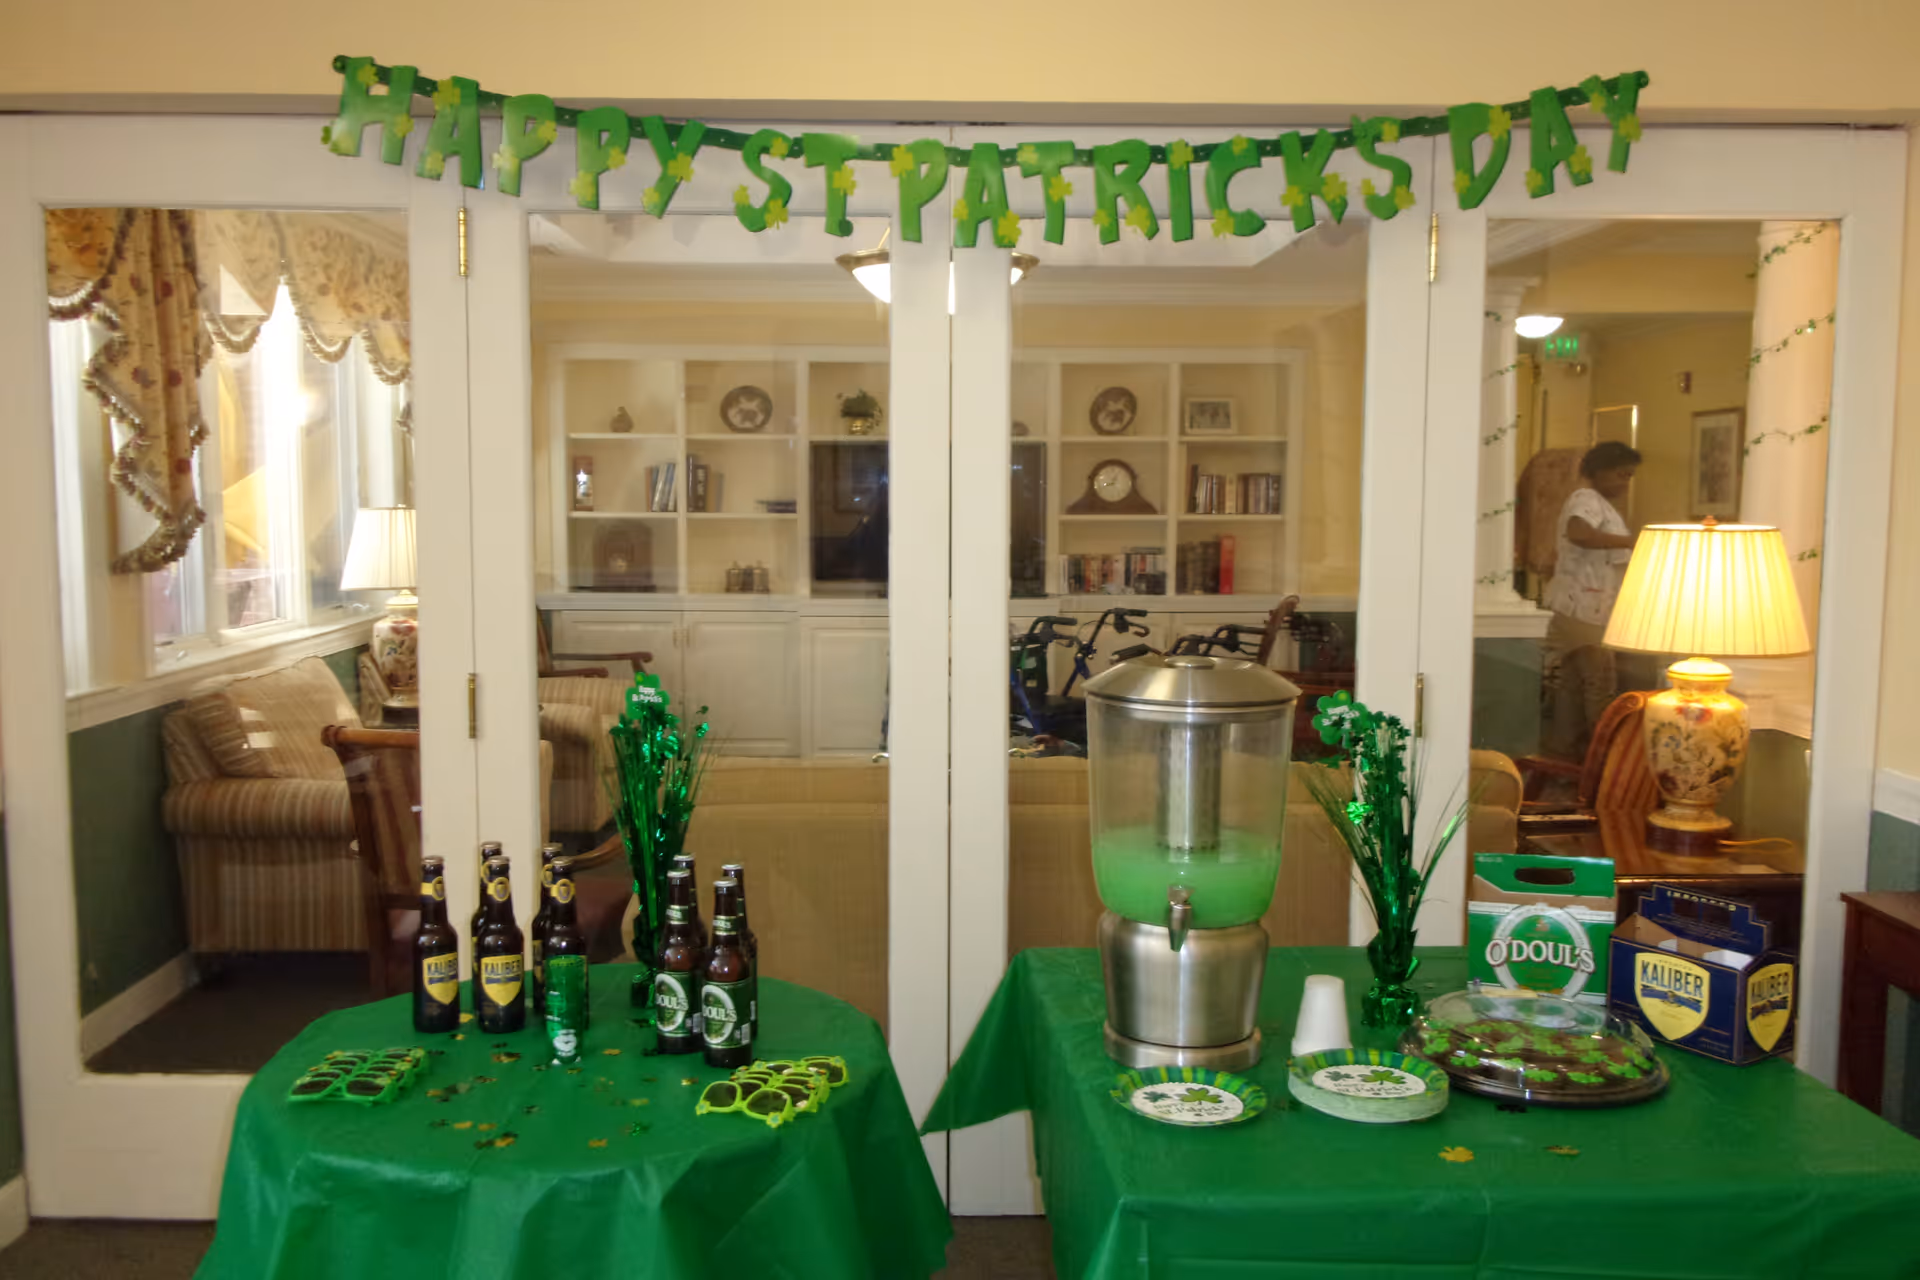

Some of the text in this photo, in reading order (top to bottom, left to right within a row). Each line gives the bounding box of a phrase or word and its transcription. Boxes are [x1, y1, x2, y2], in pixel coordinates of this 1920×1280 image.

[327, 56, 1645, 248] HAPPY ST PATRICKS DAY
[1485, 936, 1596, 974] O'DOUL'S
[1640, 959, 1704, 999] KALIBER
